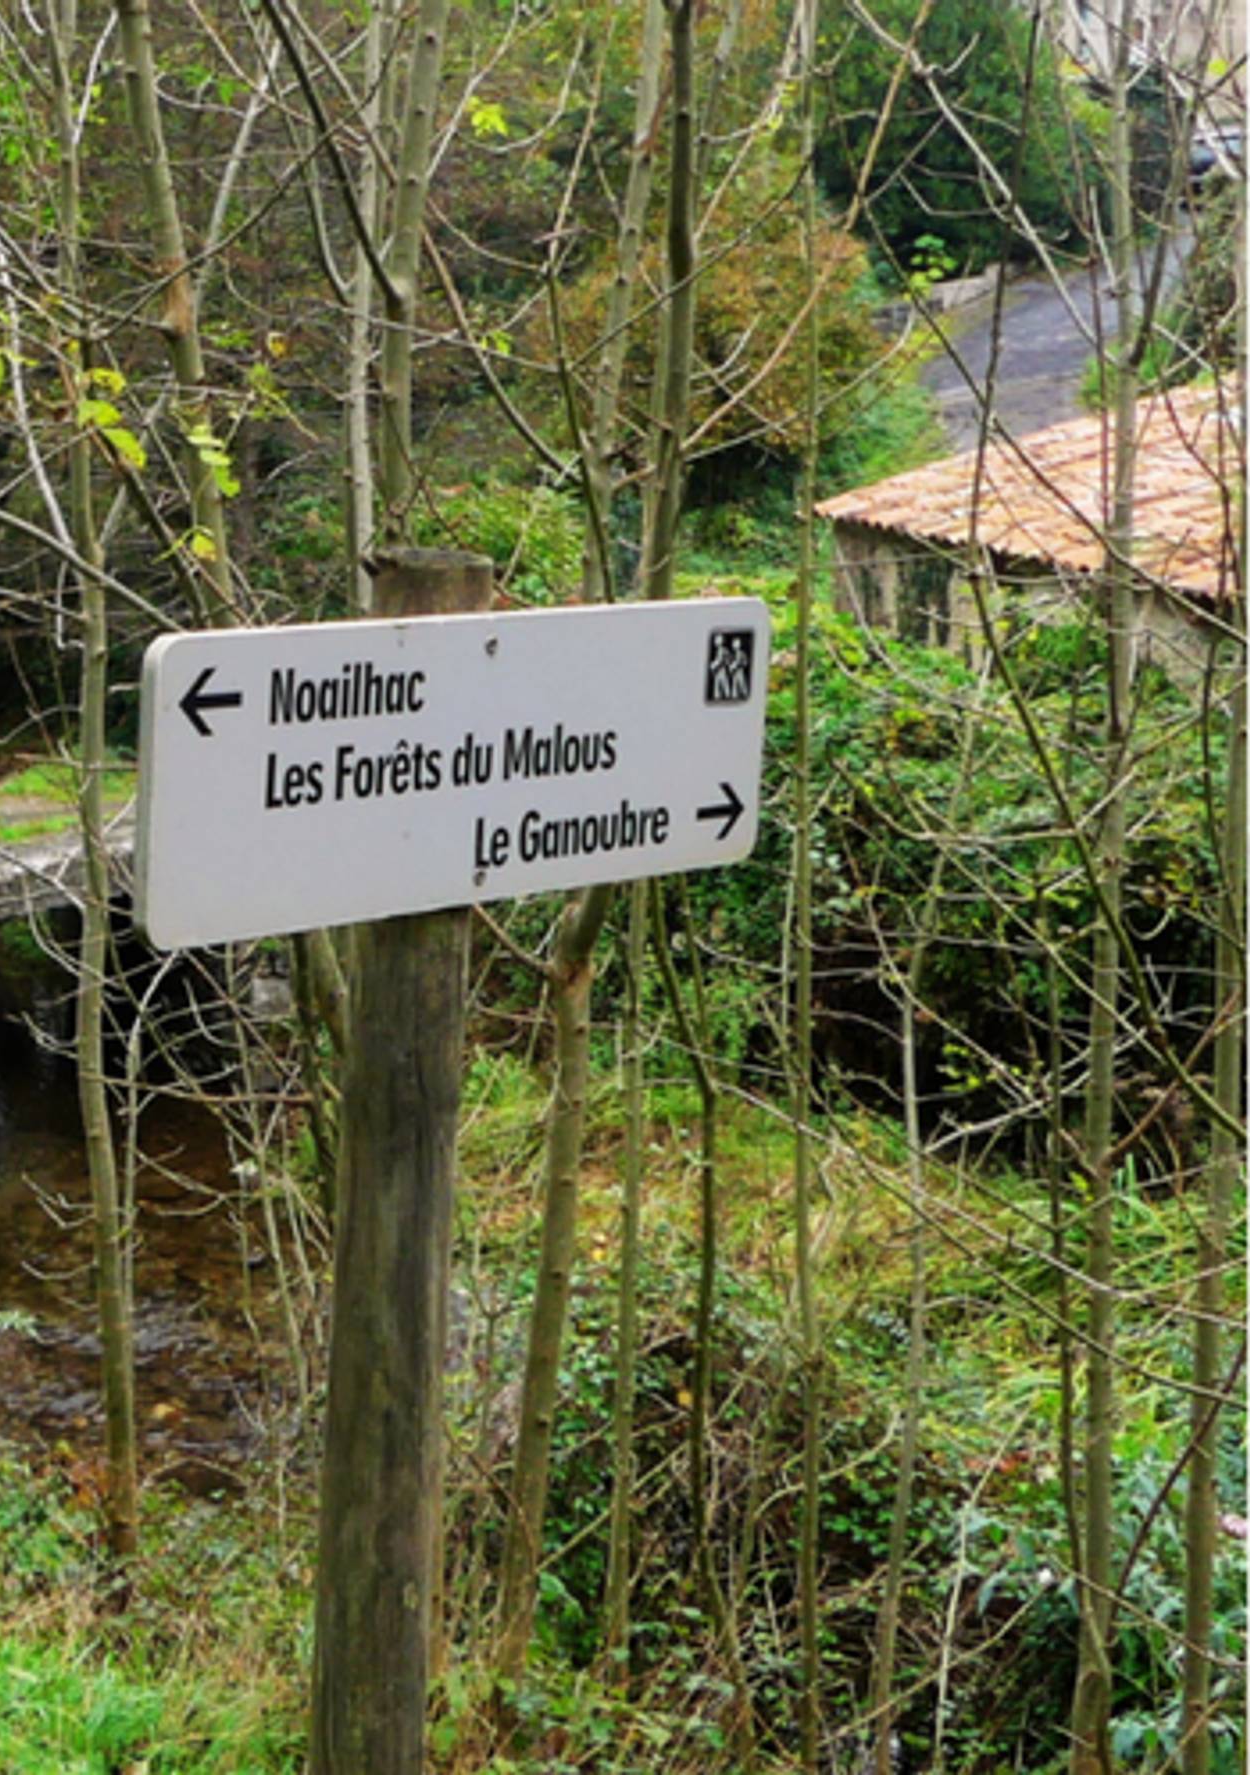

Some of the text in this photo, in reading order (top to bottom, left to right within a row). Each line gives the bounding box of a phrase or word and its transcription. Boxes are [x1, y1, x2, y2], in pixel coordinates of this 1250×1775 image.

[268, 661, 426, 726] Noailhac
[264, 722, 617, 809] Les Forêts du Malous
[473, 799, 670, 869] Le Ganoubre
